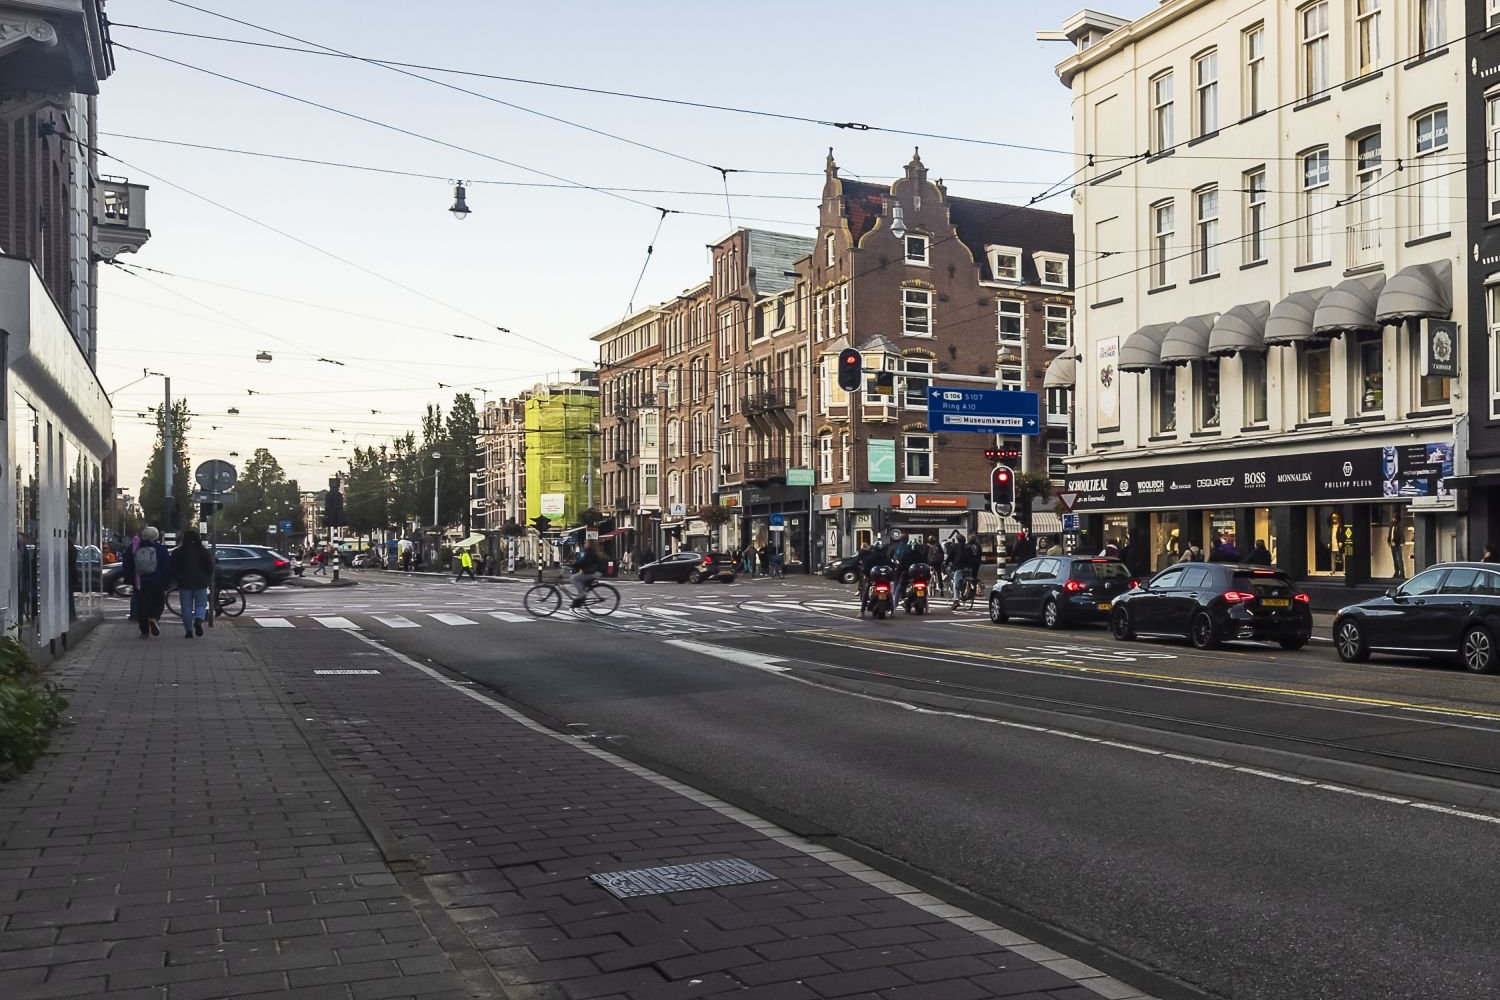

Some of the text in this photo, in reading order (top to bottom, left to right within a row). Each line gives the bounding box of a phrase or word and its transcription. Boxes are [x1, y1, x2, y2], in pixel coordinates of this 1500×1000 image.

[942, 402, 960, 411] Ring
[963, 416, 1021, 426] Museumkwartier
[1244, 471, 1266, 485] BOSS
[1277, 472, 1312, 483] MONNALISA
[1137, 479, 1165, 489] WOOLRICH
[1324, 481, 1350, 489] PHILIPP
